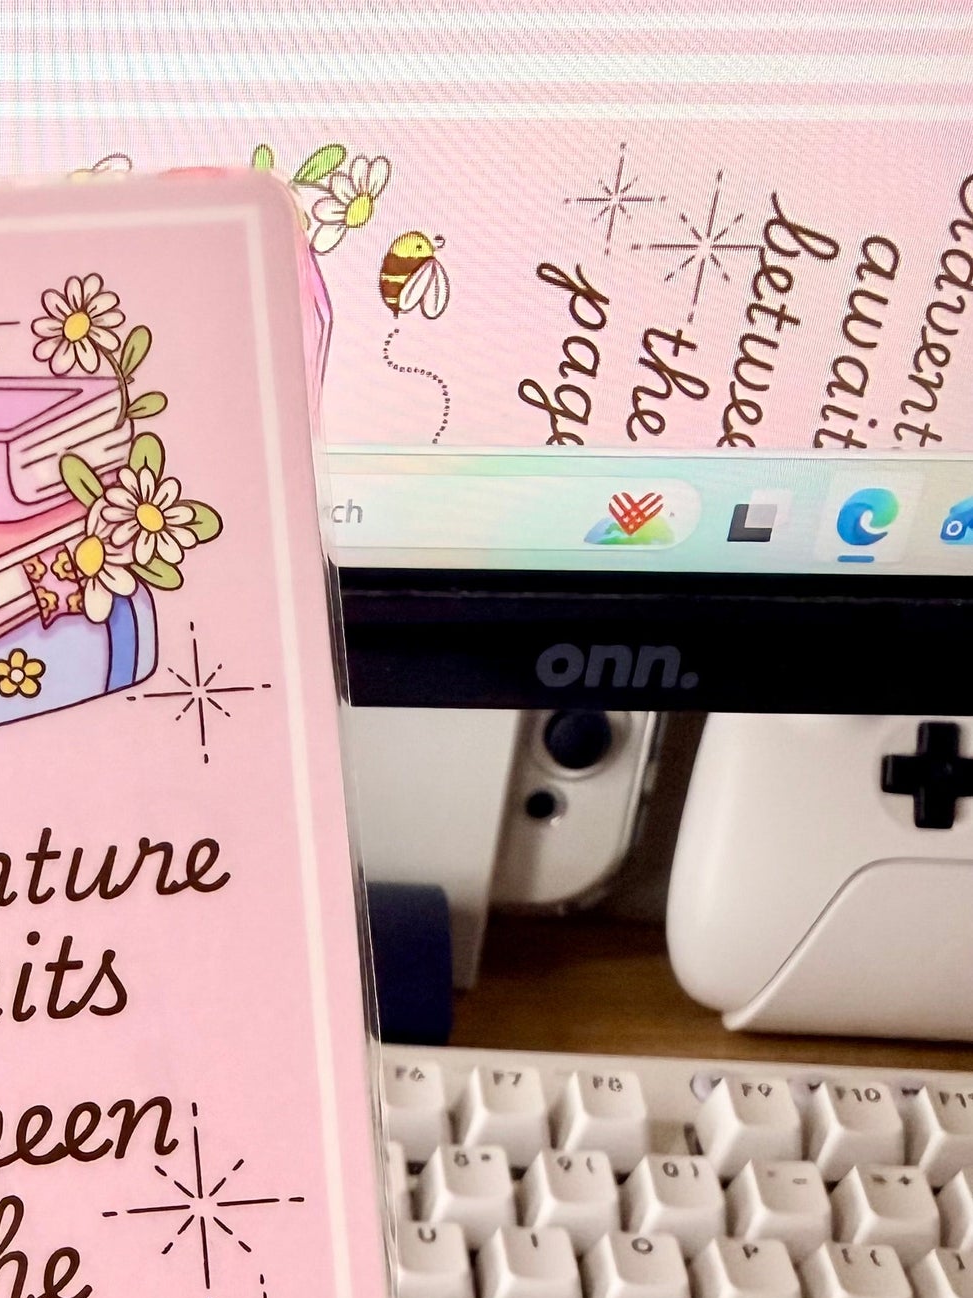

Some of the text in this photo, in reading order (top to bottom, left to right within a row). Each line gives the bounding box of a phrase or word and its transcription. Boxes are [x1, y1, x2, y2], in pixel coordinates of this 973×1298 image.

[626, 328, 710, 442] the
[535, 642, 700, 690] onn.
[417, 1226, 437, 1244] U
